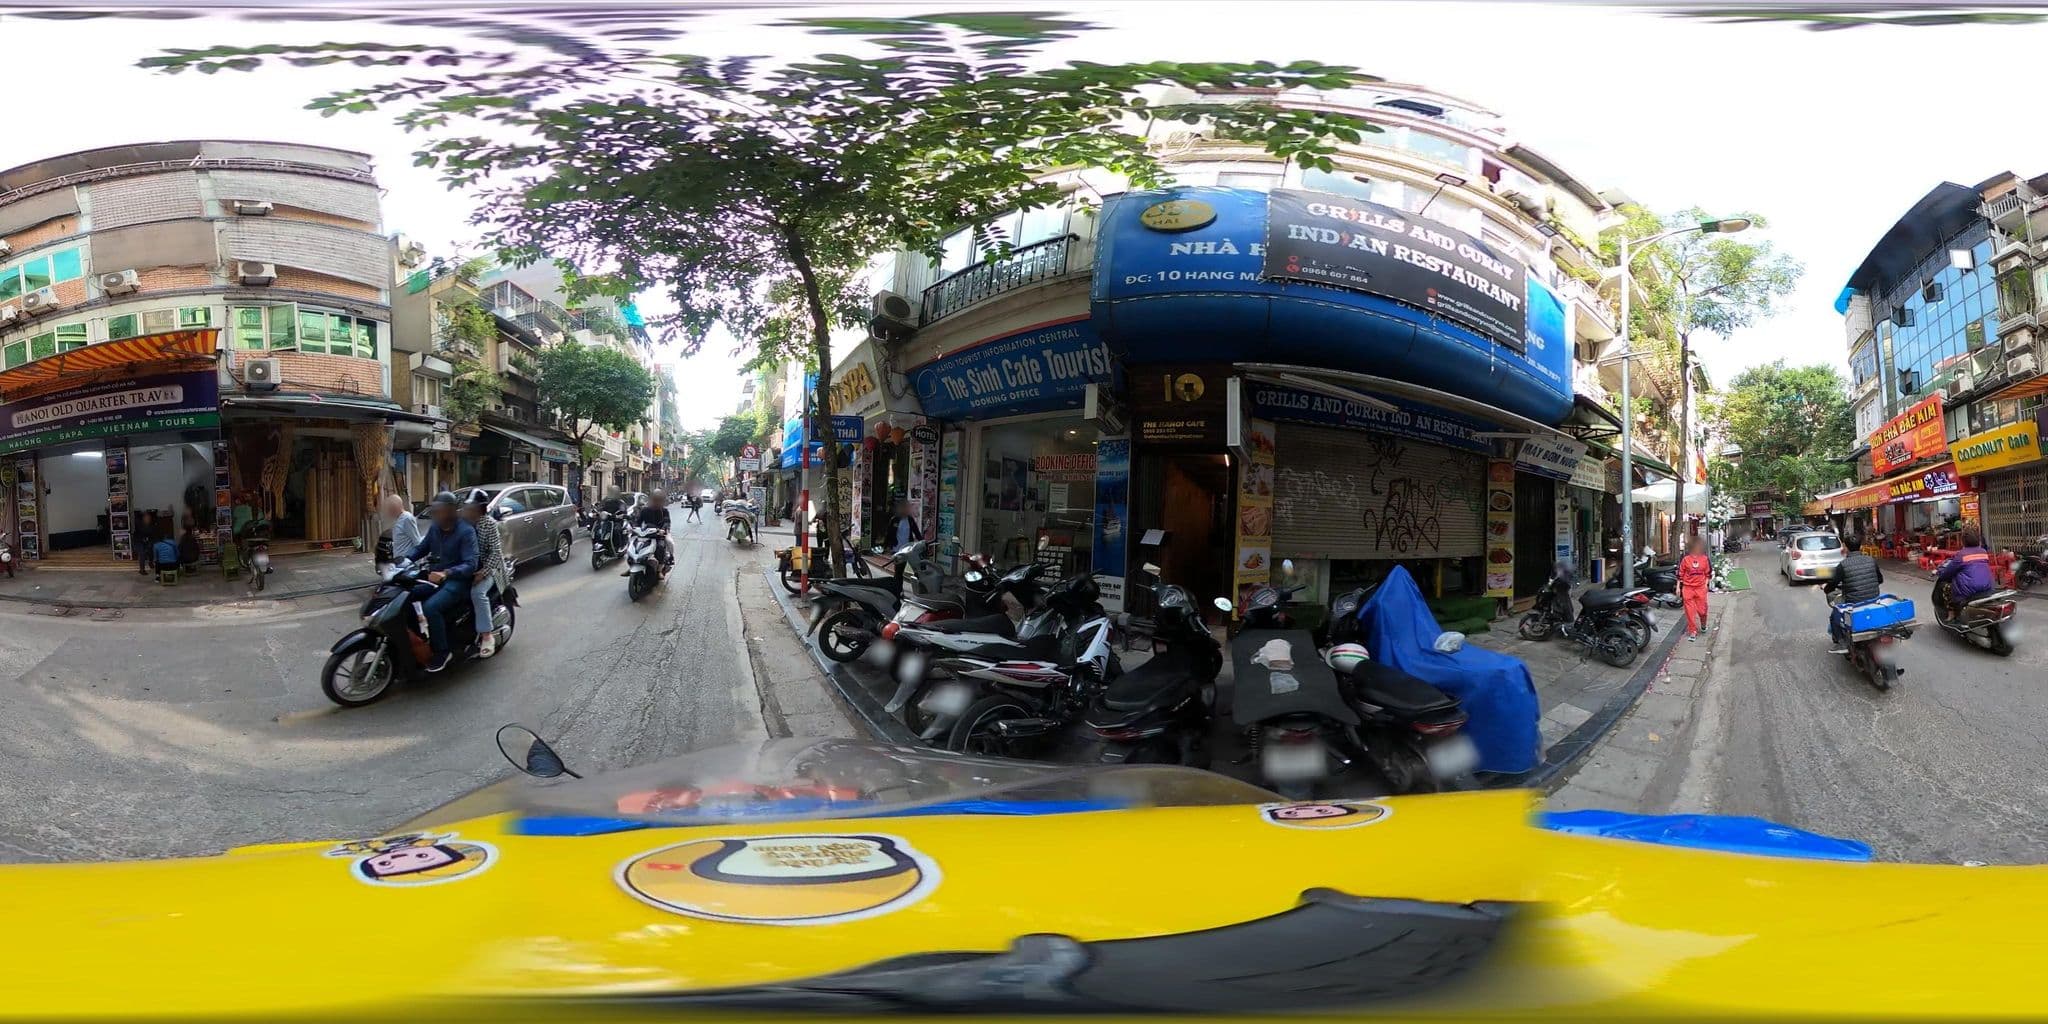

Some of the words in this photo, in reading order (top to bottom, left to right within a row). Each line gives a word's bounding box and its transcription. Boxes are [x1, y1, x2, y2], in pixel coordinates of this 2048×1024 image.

[1170, 238, 1240, 256] NHÀ
[1408, 224, 1456, 251] AND
[1457, 243, 1515, 281] CURRY
[1157, 270, 1181, 281] 10
[1185, 271, 1235, 281] HANG
[1329, 271, 1347, 279] 607
[1393, 244, 1521, 311] RESTAURANT
[955, 351, 982, 366] TOURIST
[983, 338, 1036, 358] INFORMATION
[1038, 328, 1080, 344] CENTRAL
[941, 375, 970, 401] The
[966, 363, 1005, 396] Sinh
[1001, 354, 1043, 388] Cafe
[1042, 341, 1113, 380] Tourist
[840, 361, 876, 404] SPA
[970, 393, 1007, 408] BOOKING
[1009, 387, 1040, 400] OFFICE
[17, 411, 49, 425] HANOI
[51, 403, 73, 417] OLD
[76, 394, 128, 412] QUARTER
[1256, 390, 1309, 409] GRILLS
[1312, 396, 1343, 415] AND
[1345, 401, 1390, 421] CURRY
[1391, 411, 1431, 431] INDAN
[1433, 420, 1493, 446] RESTARANT
[1917, 403, 1937, 425] KIM
[158, 417, 195, 427] TOURS
[1185, 420, 1206, 428] CAFE
[9, 436, 42, 449] HALONG
[60, 430, 83, 440] SAPA
[103, 421, 149, 433] VIETNAM
[915, 430, 937, 441] HOTEL
[1957, 438, 2004, 462] COCONUT
[2007, 433, 2030, 449] Cafe
[1035, 455, 1070, 471] BOOKING
[1912, 478, 1925, 492] KIM
